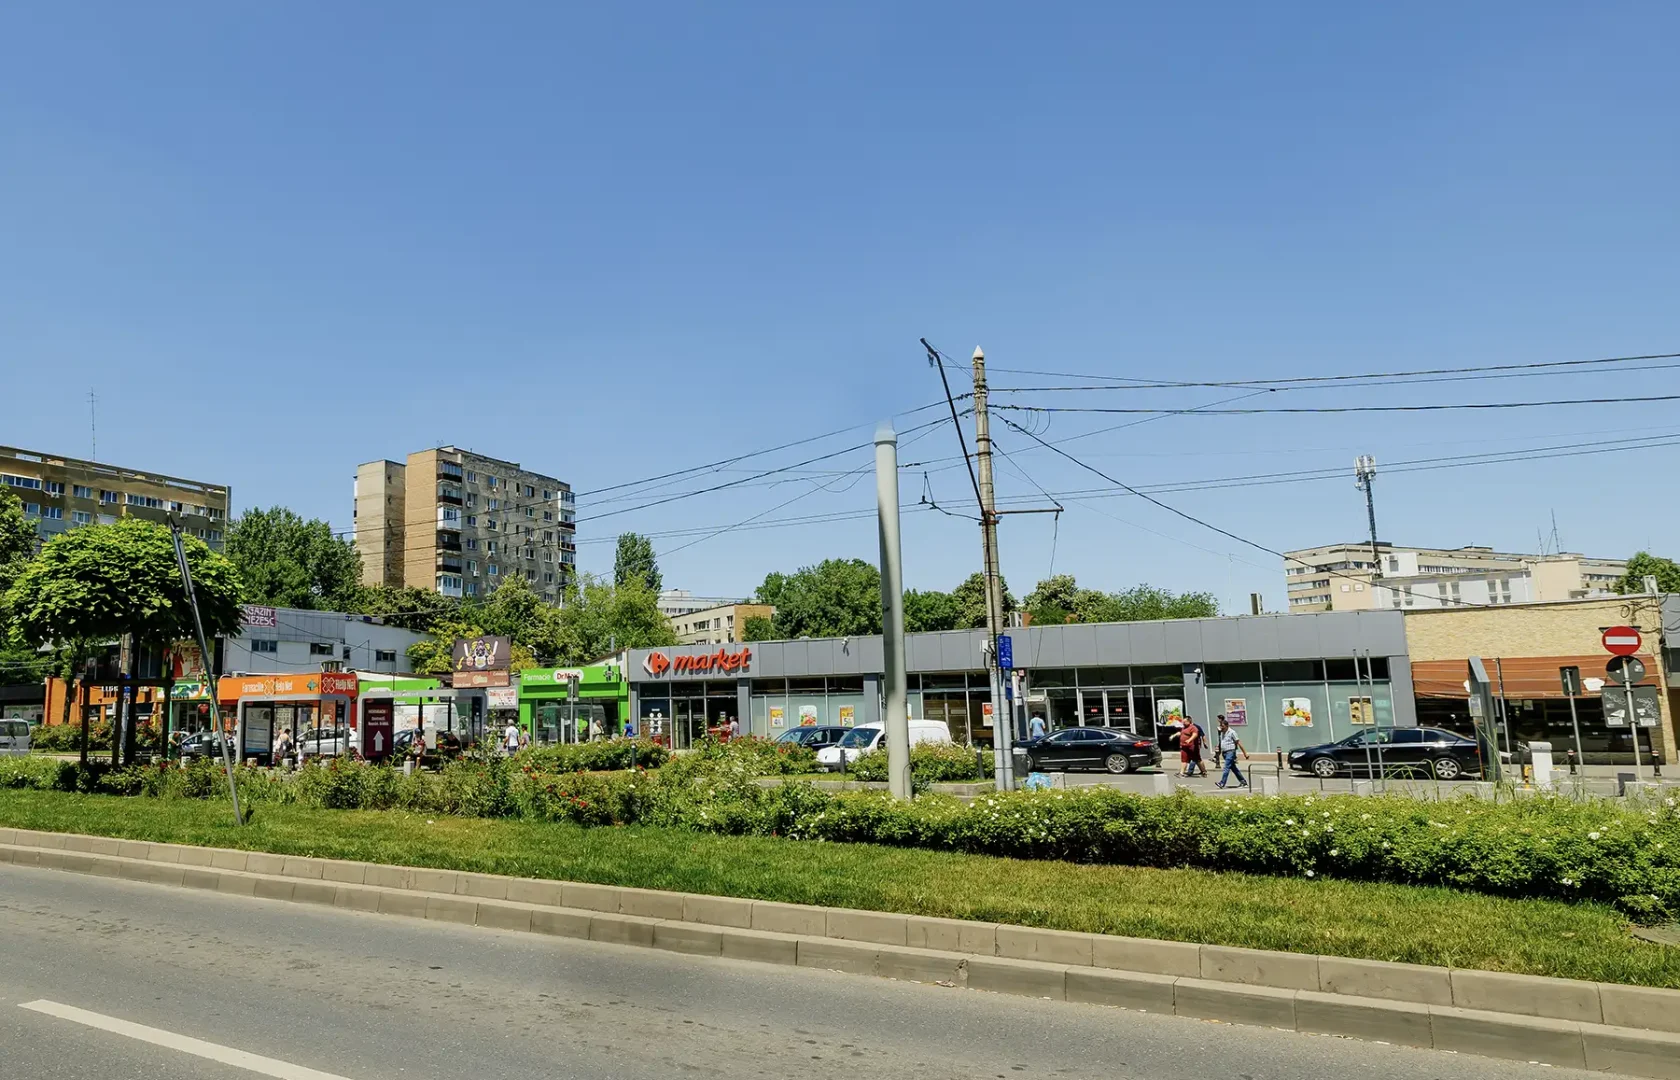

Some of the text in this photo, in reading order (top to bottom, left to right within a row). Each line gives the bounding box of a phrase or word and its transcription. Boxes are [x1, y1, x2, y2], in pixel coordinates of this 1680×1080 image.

[673, 647, 752, 671] market
[523, 673, 551, 682] Farmacie
[335, 679, 347, 692] Help
